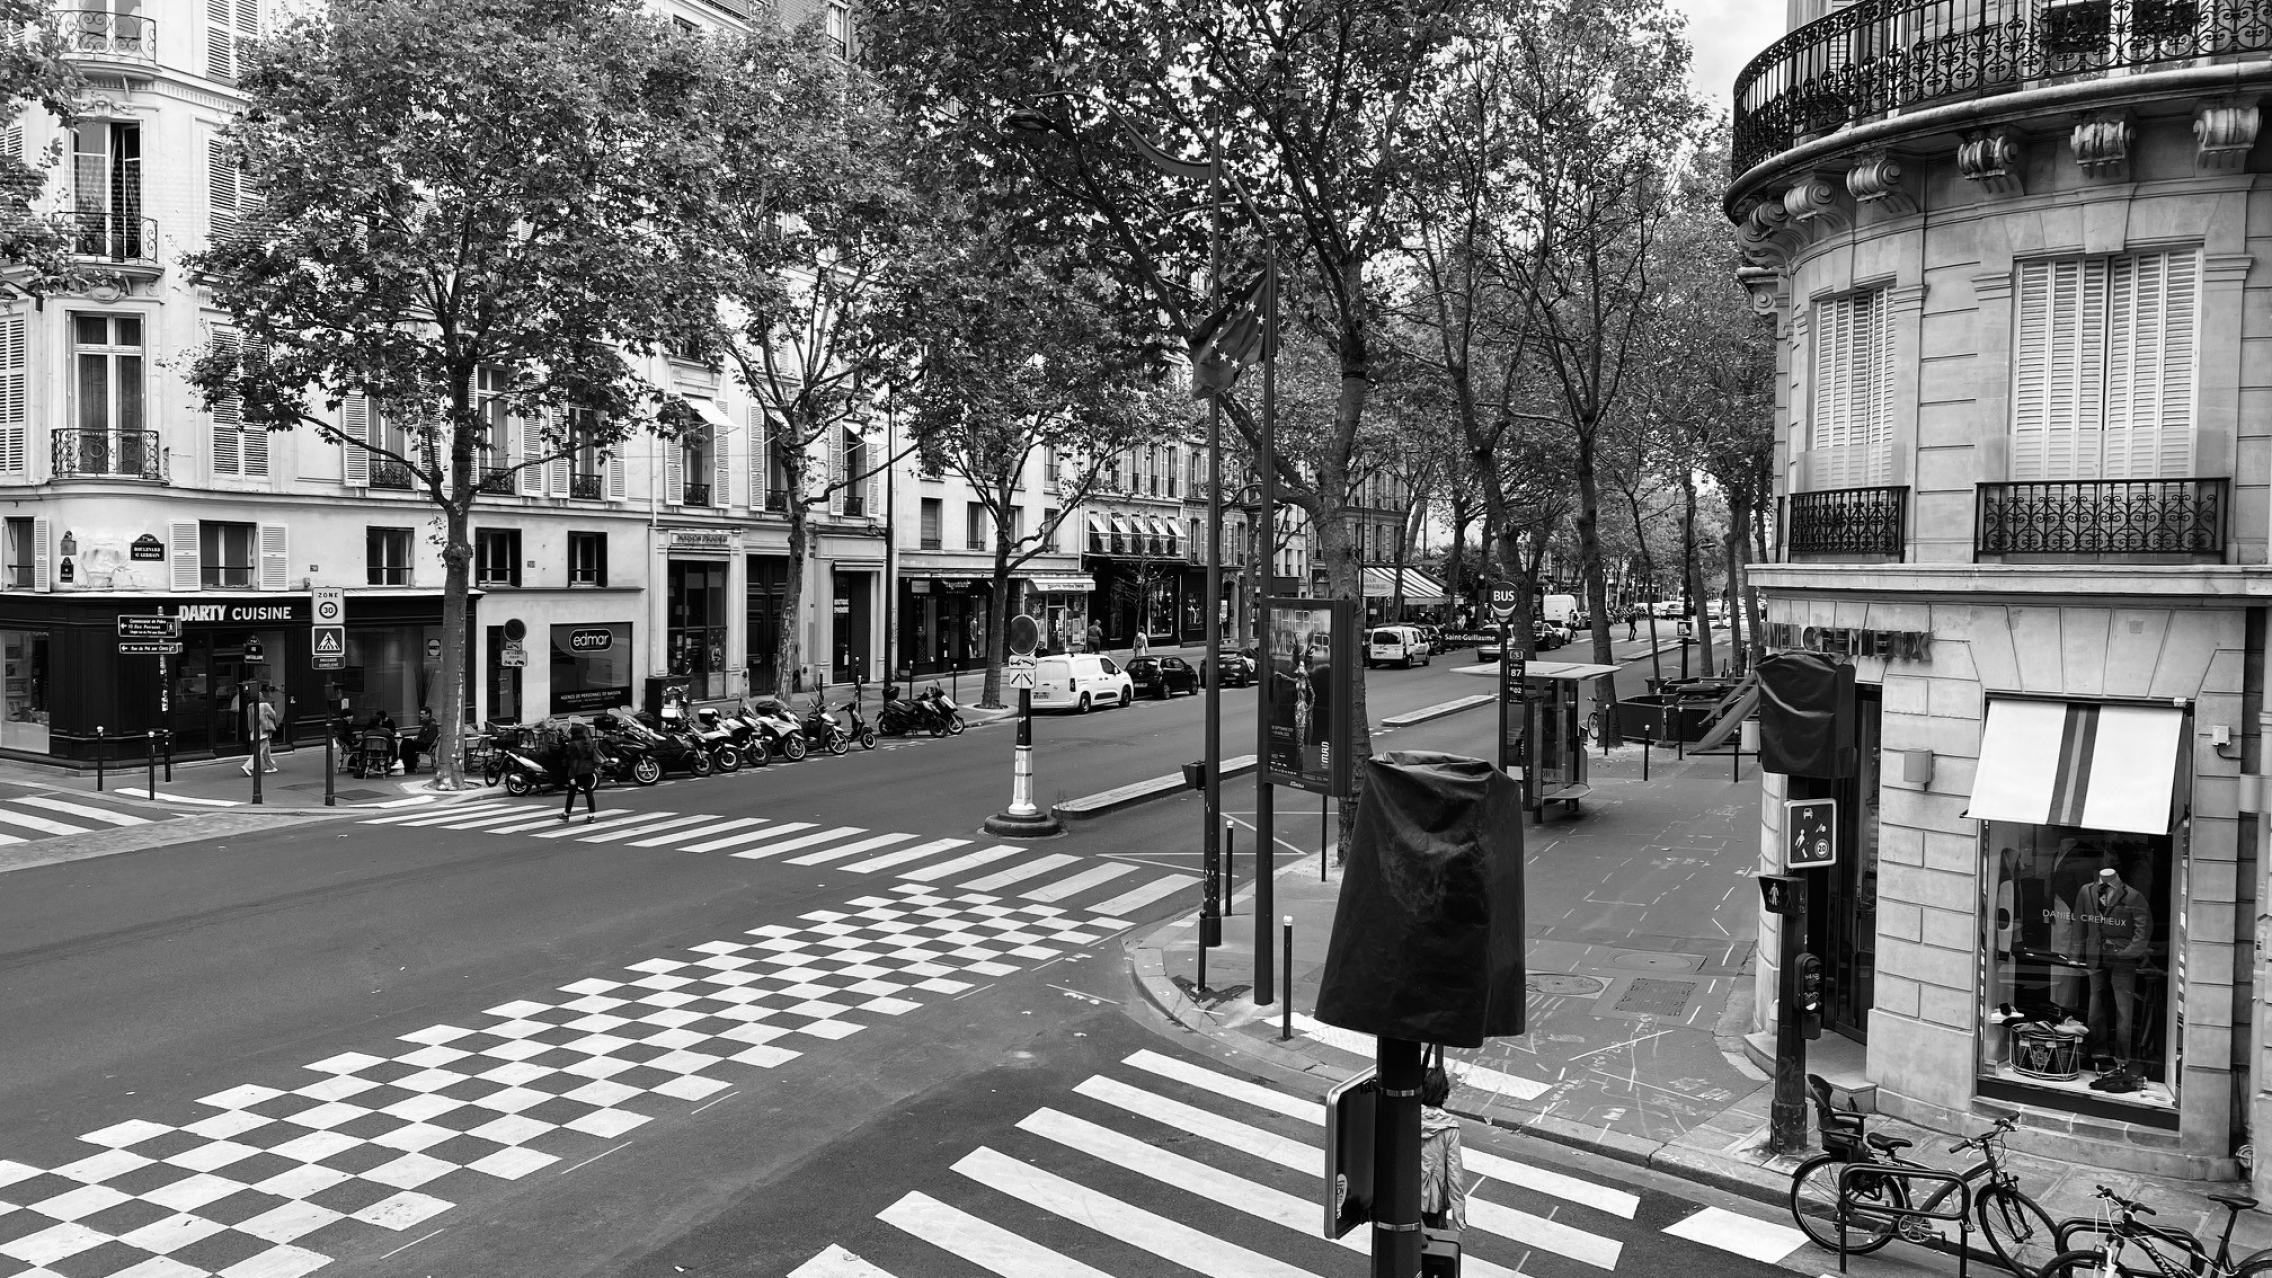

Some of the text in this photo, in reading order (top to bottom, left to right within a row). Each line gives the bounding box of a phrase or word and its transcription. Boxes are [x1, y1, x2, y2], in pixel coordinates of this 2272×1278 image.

[1493, 590, 1516, 602] BUS
[178, 604, 292, 622] DARTY CUISINE
[323, 606, 334, 614] 30
[573, 632, 609, 647] edmar
[1510, 668, 1522, 677] 87
[2042, 908, 2077, 922] DANIEL
